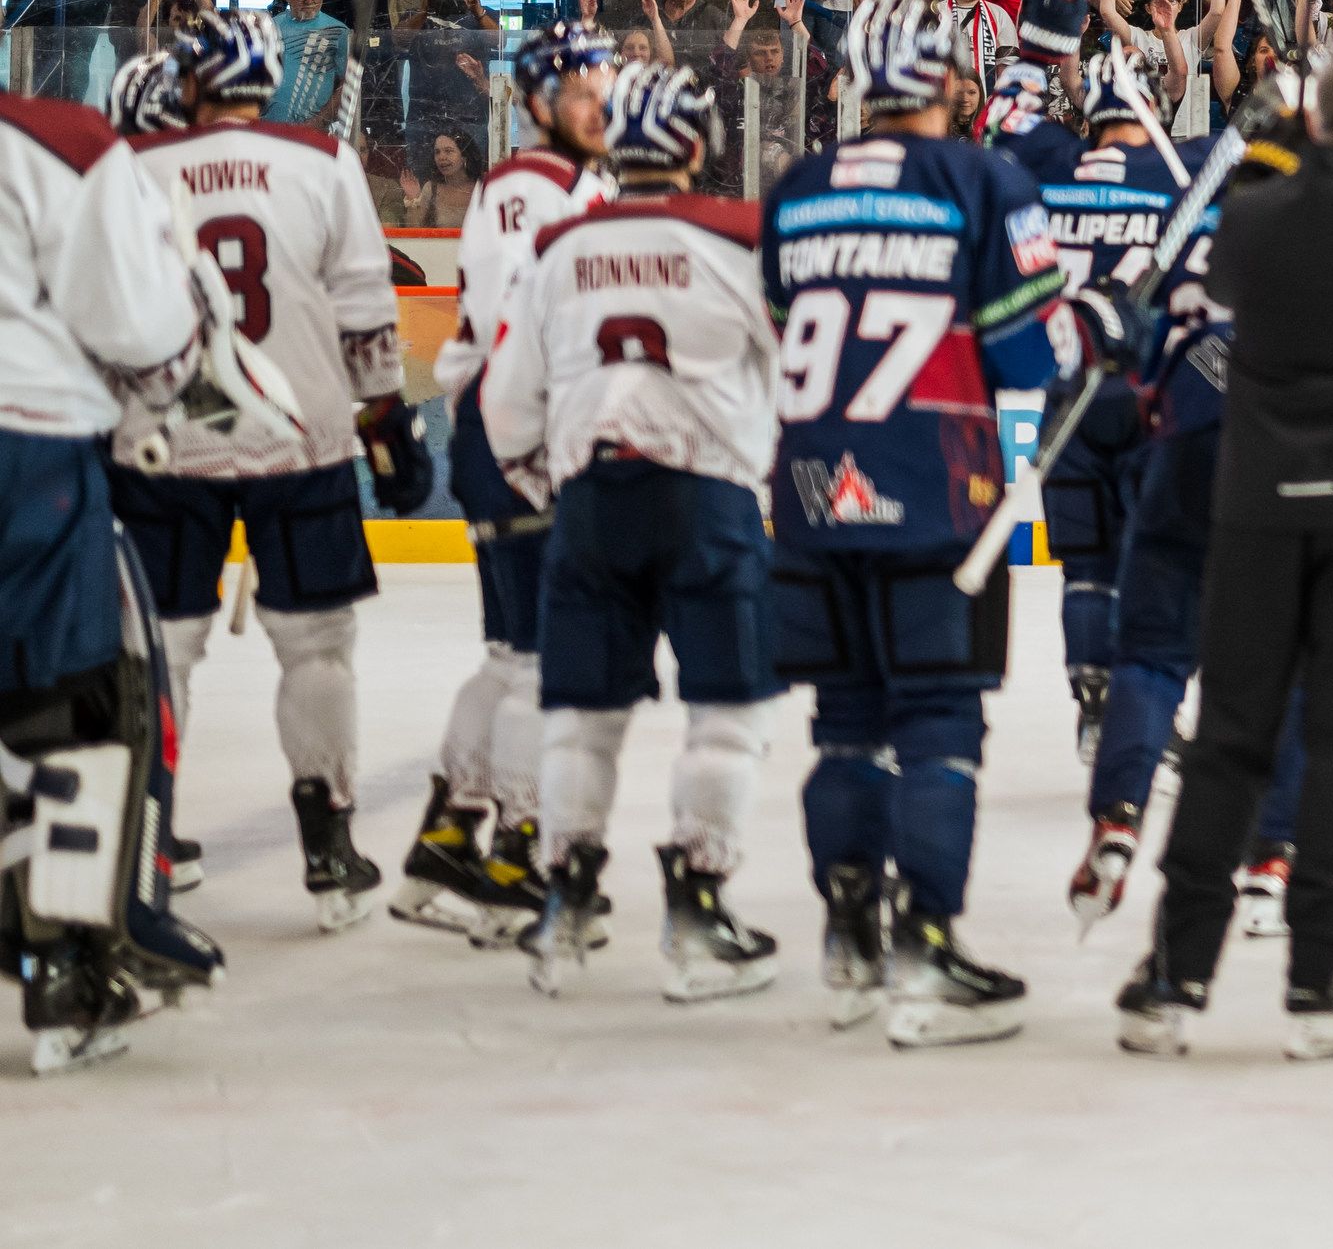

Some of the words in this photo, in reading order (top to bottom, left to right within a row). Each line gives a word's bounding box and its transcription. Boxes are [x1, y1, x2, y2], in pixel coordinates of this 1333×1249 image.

[499, 195, 526, 234] 12
[779, 232, 960, 283] FONTAINE
[777, 286, 957, 423] 97
